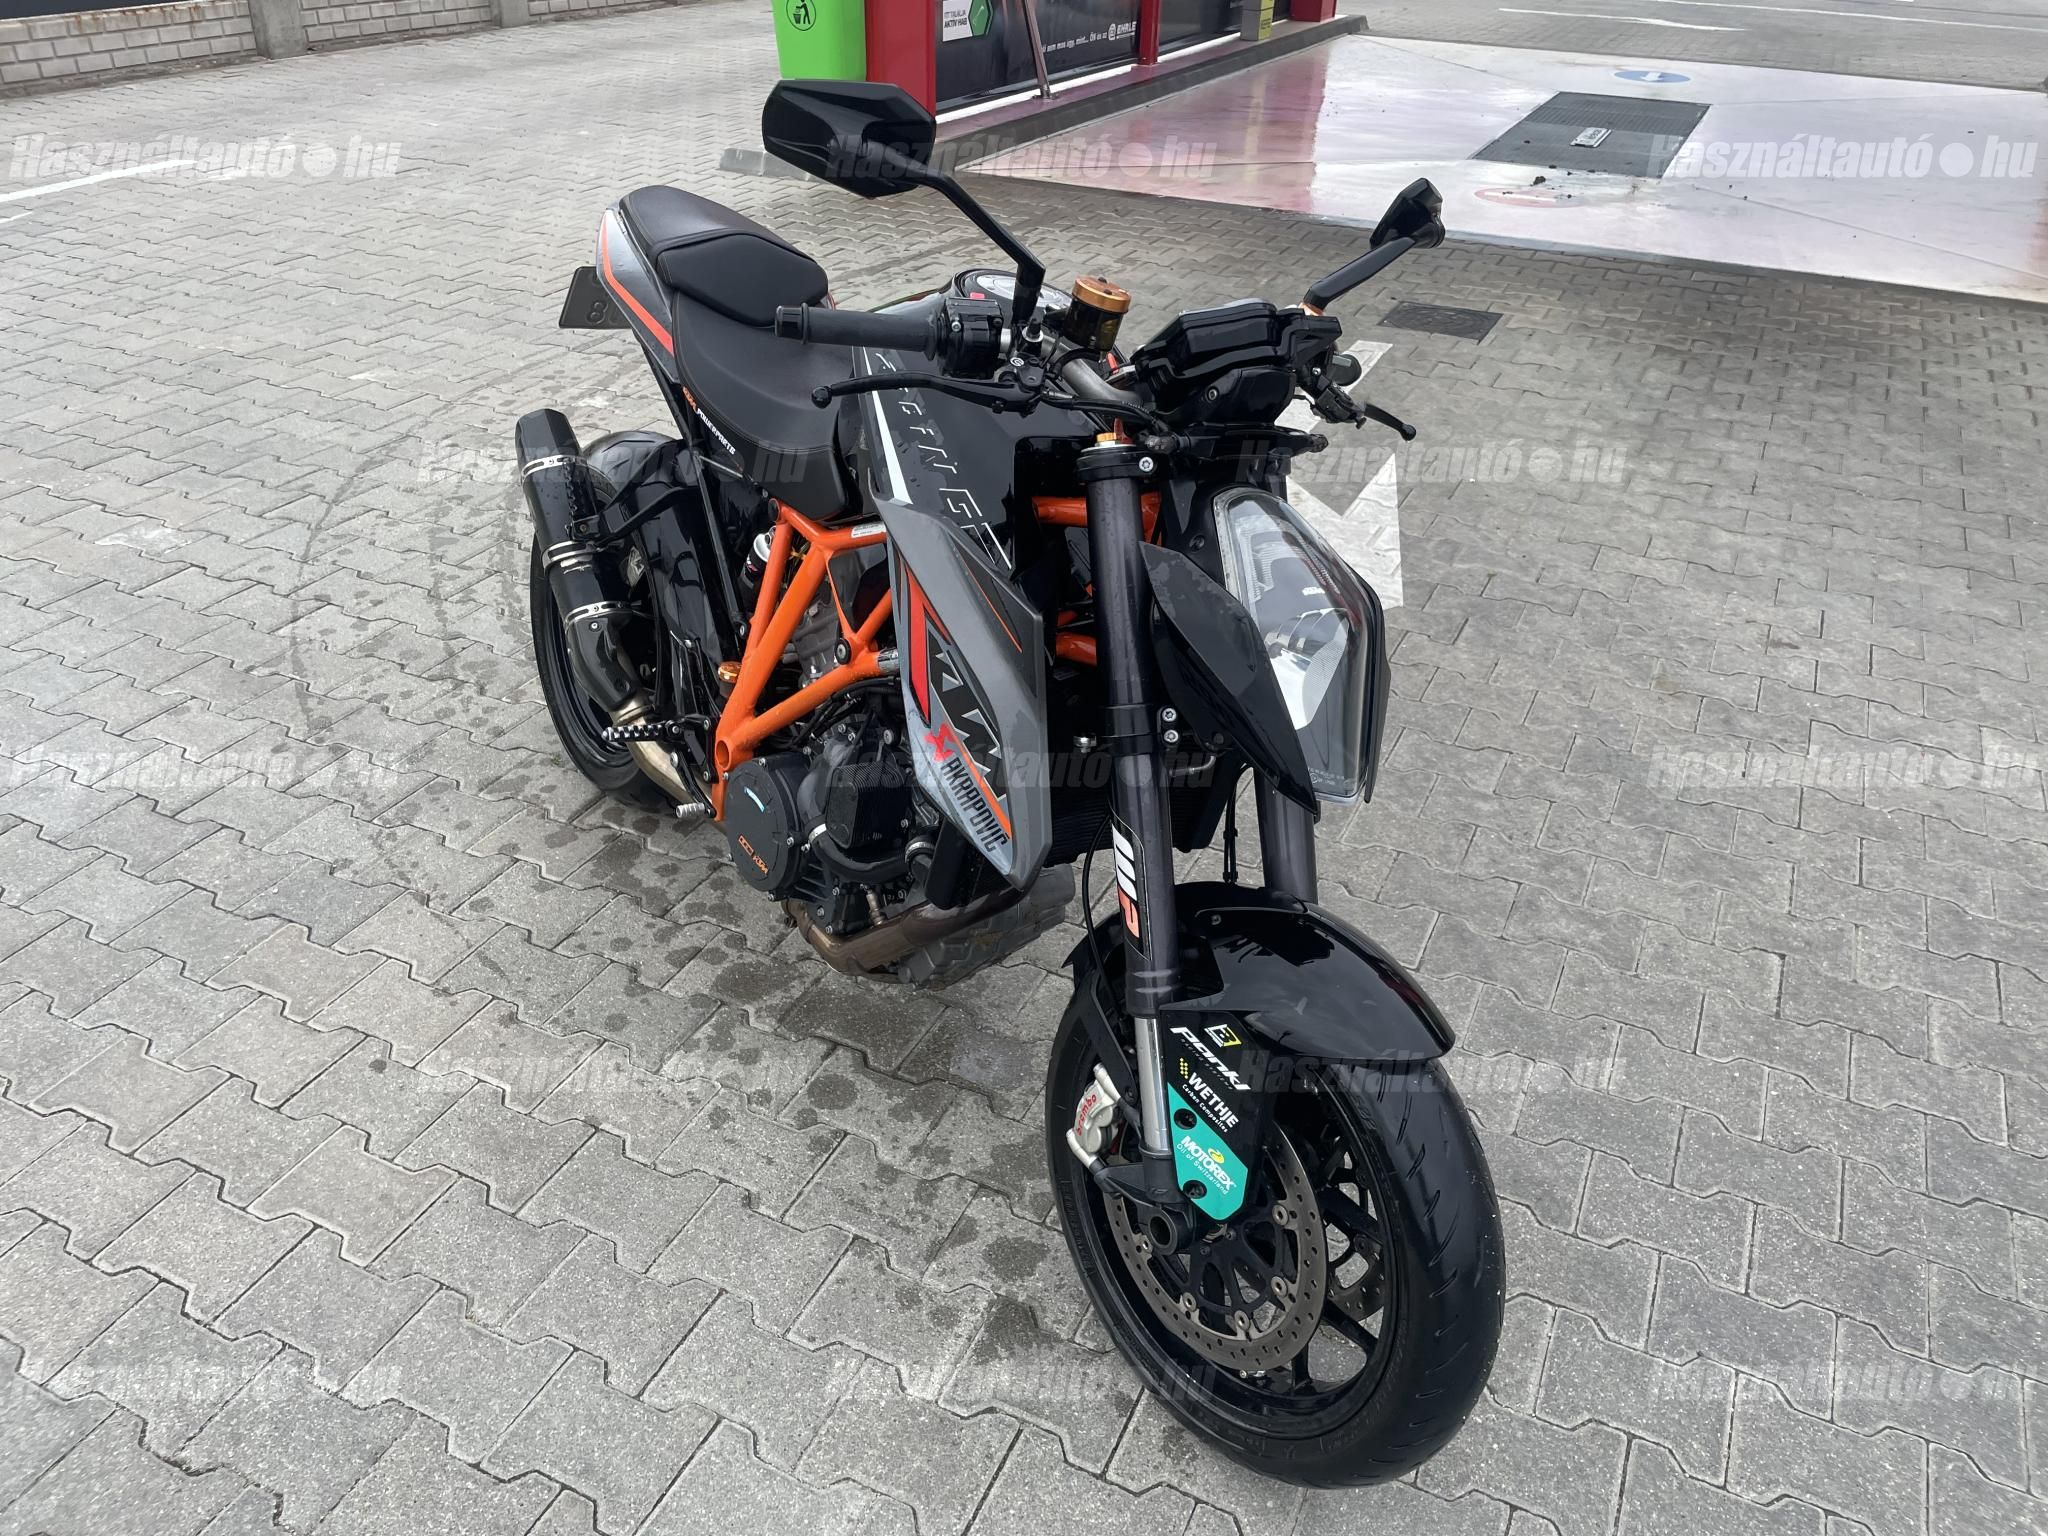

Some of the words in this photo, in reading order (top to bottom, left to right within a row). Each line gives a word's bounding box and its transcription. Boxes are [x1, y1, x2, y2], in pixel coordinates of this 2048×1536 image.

[1117, 21, 1137, 35] EHRLE
[1188, 1072, 1240, 1128] WETHJE
[1181, 1135, 1234, 1191] MOTOREX
